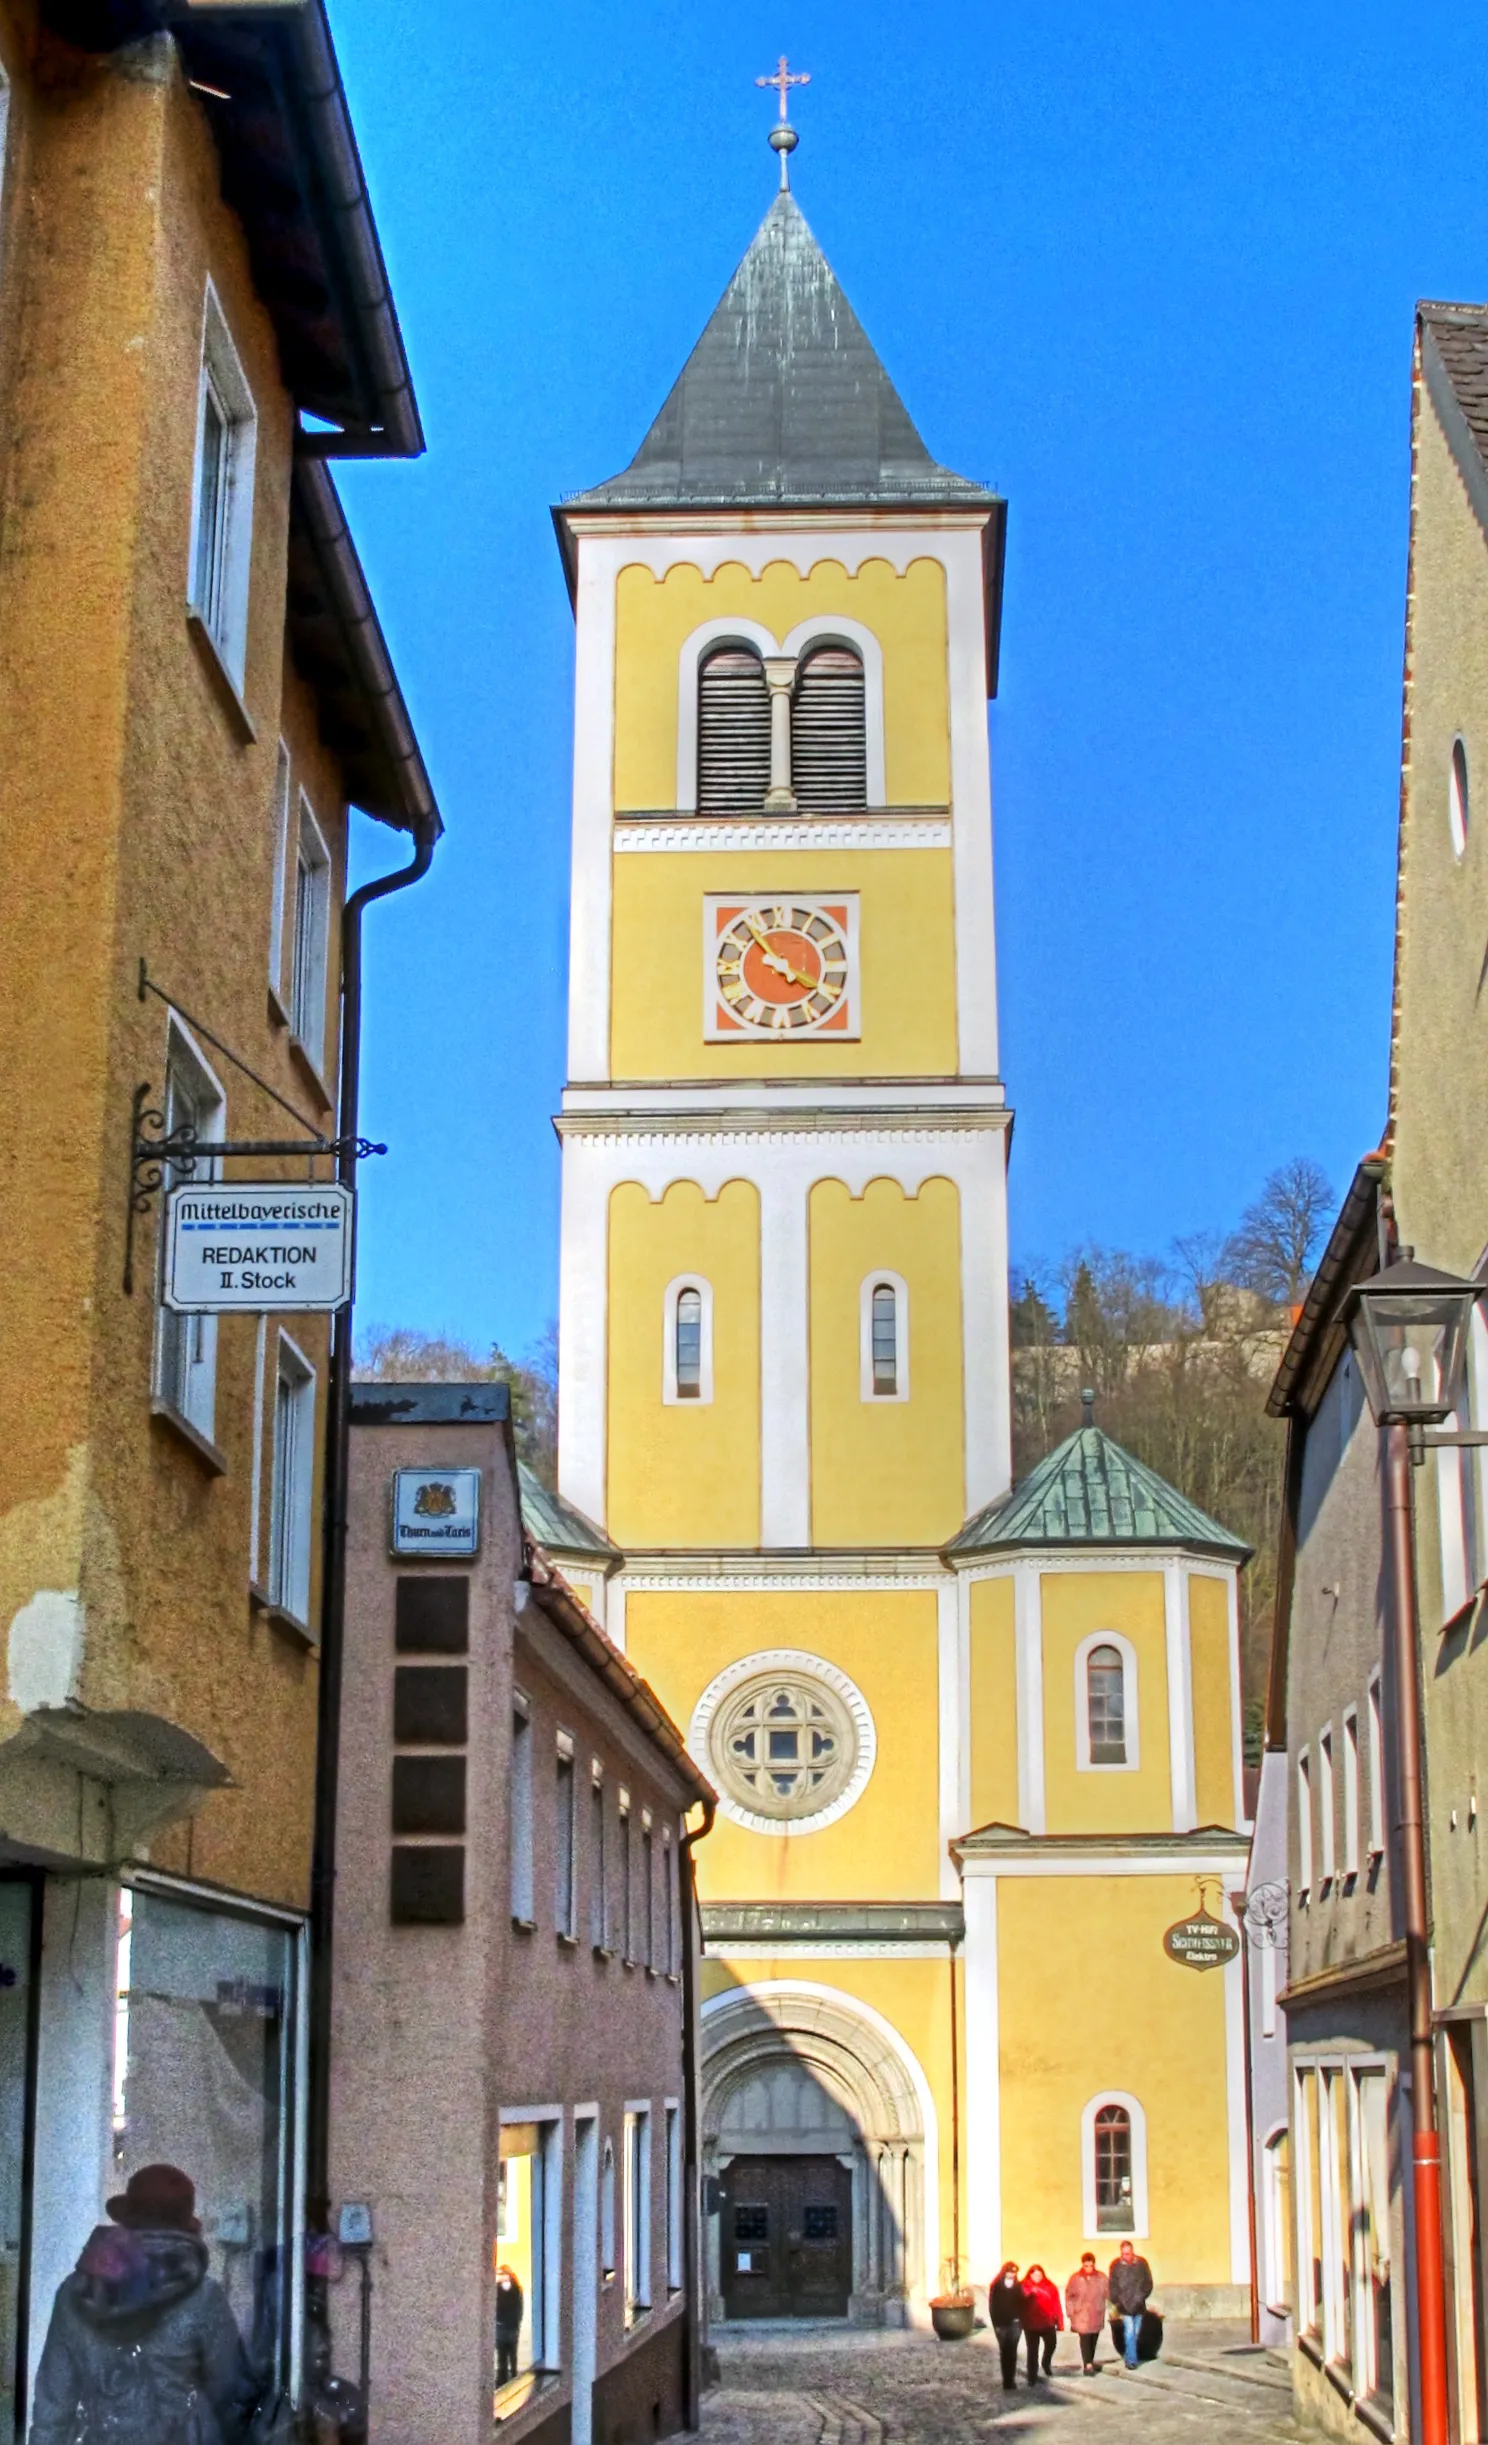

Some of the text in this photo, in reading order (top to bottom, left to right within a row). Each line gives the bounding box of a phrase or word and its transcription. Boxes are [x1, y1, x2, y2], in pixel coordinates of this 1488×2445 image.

[181, 1202, 340, 1221] Mittelbayerische
[202, 1247, 316, 1264] REDAKTION
[1186, 1950, 1218, 1961] Elektro
